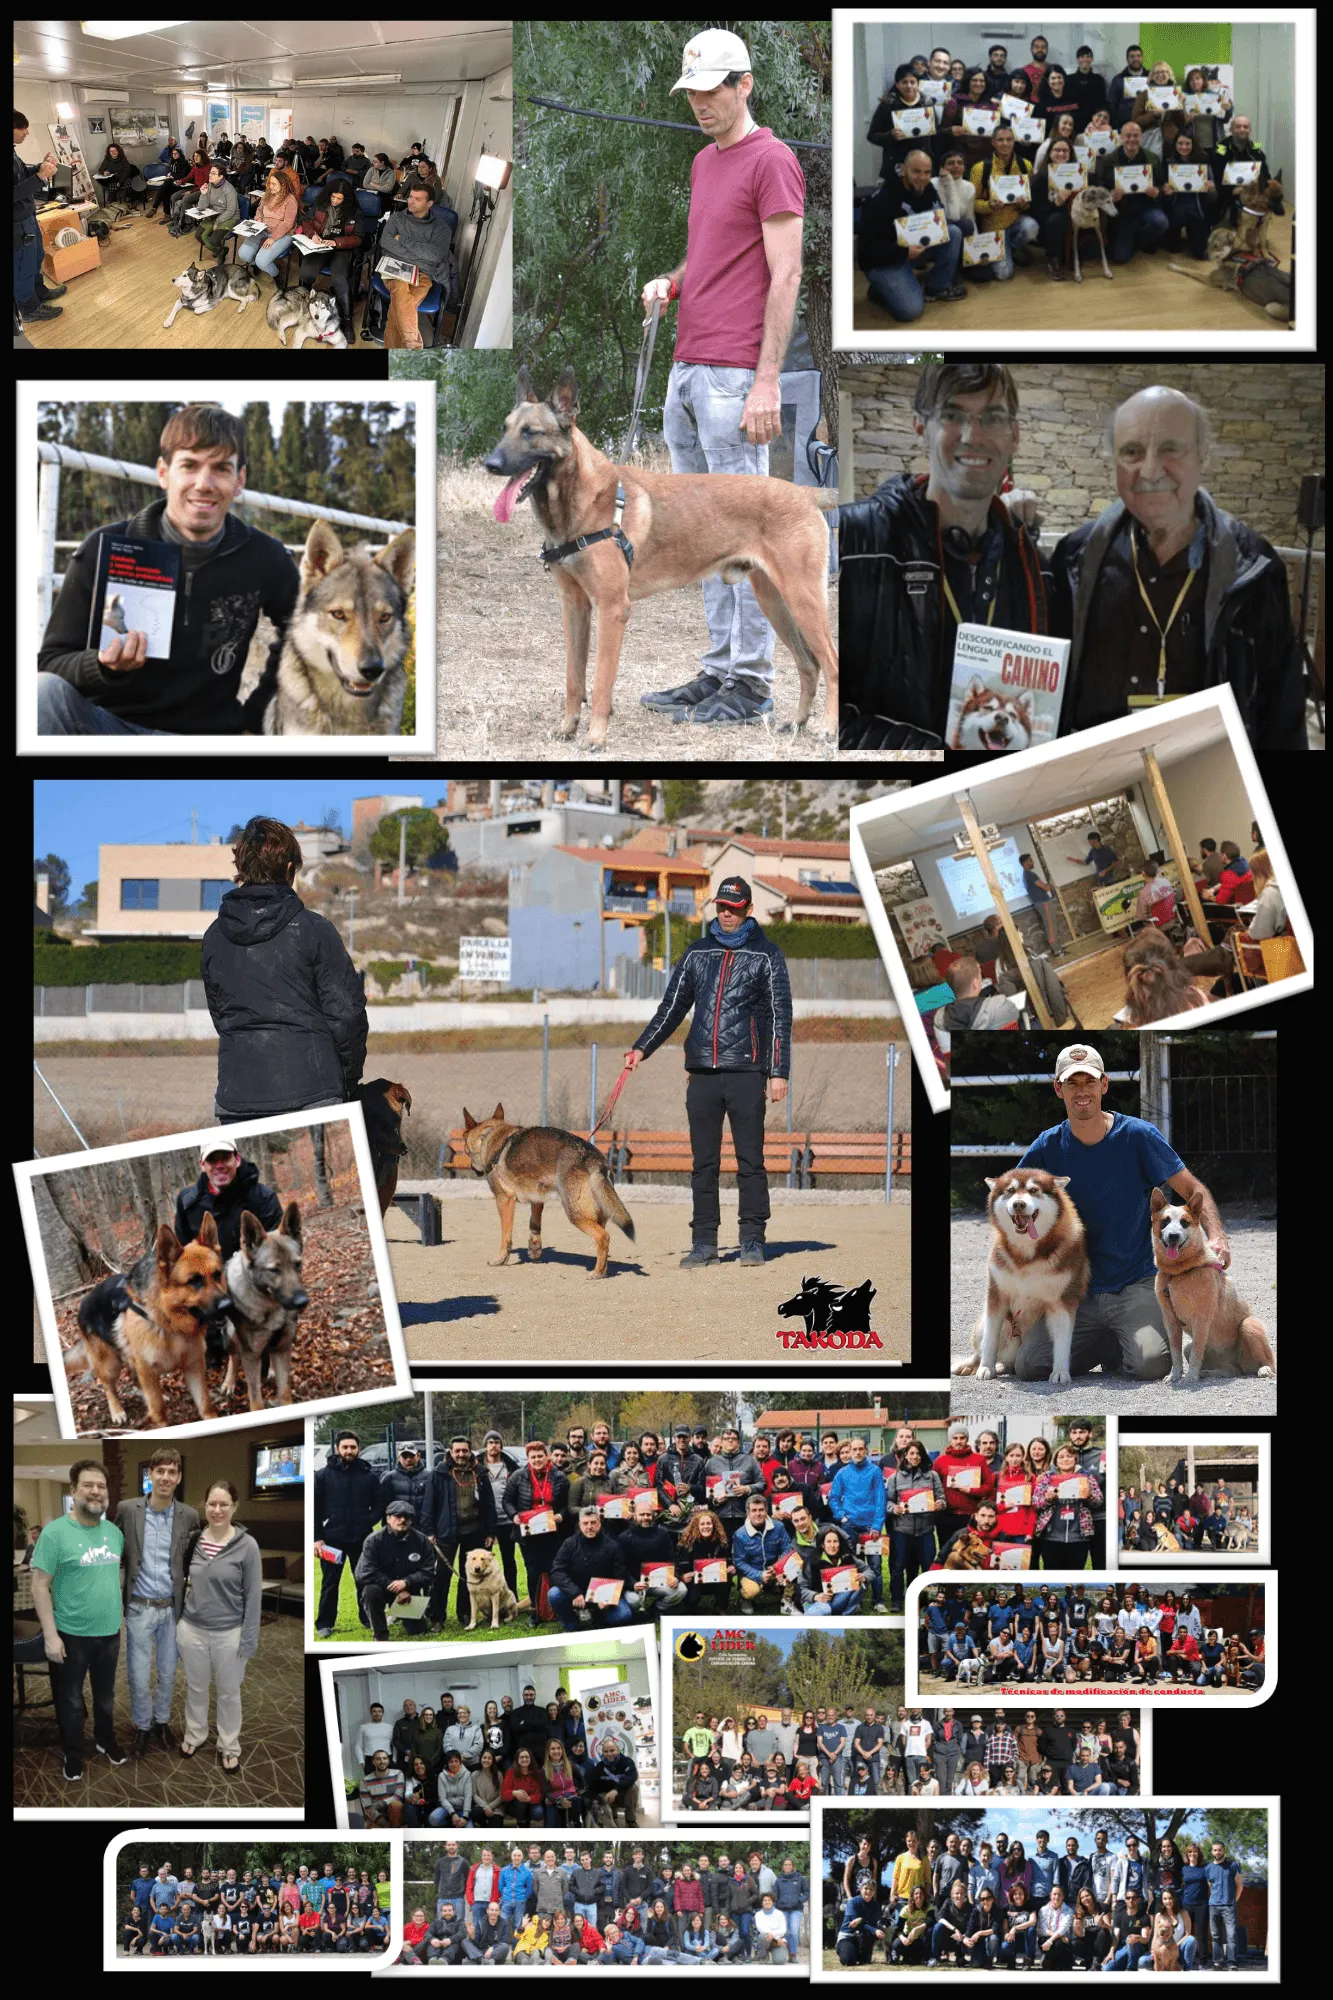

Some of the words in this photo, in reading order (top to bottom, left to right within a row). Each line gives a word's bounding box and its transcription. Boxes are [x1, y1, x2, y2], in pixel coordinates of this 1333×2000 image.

[957, 642, 1003, 658] LENGUAJE
[959, 631, 1041, 654] DESCODIFICANDO
[1043, 647, 1054, 657] EL
[1001, 652, 1060, 693] CANINO
[603, 1690, 621, 1699] AMC
[603, 1695, 627, 1705] LIDER
